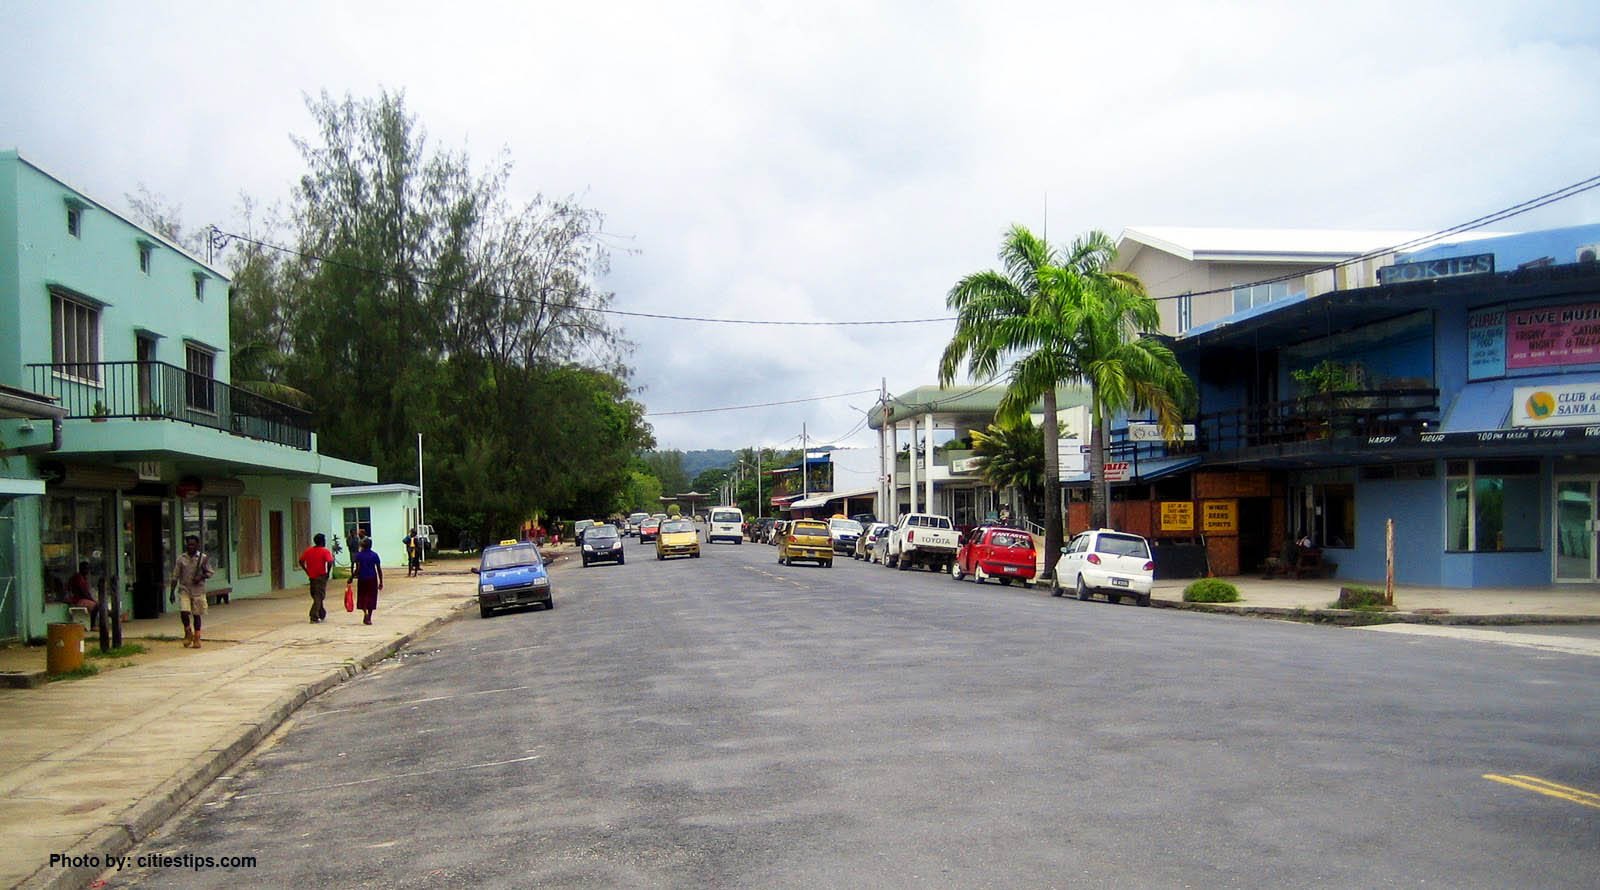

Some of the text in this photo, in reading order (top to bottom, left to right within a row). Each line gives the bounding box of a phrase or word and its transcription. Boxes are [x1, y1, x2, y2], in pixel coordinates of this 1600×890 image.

[1384, 256, 1492, 281] POKIES
[1516, 310, 1557, 325] LIVE
[1558, 392, 1585, 402] CLUB
[1558, 403, 1596, 415] SANMA
[1368, 436, 1396, 445] HAPPY
[1421, 434, 1445, 443] HOUR
[921, 536, 951, 545] TOYOTA
